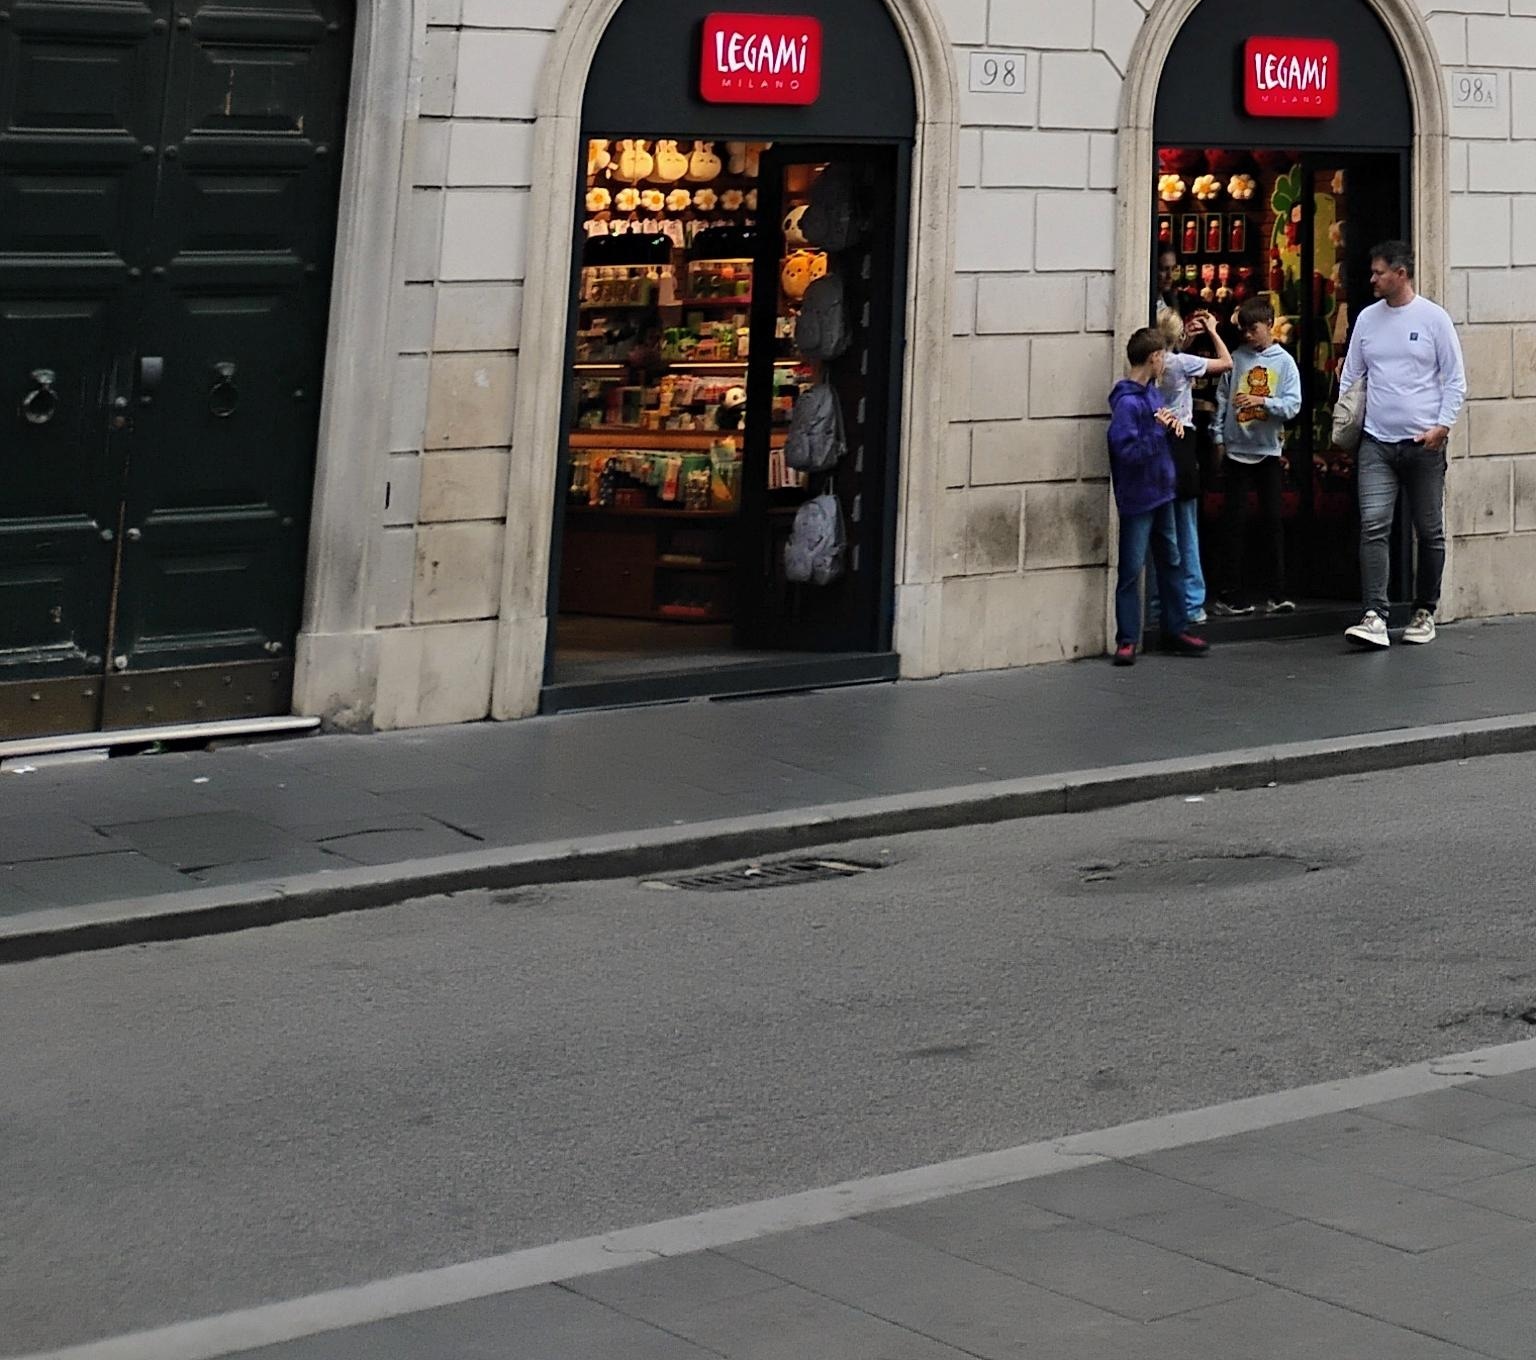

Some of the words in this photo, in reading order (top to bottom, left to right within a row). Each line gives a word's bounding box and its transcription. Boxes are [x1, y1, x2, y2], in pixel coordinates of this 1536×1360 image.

[979, 58, 1017, 87] 98
[721, 78, 800, 90] MILANO
[1455, 77, 1494, 104] 98A
[1260, 94, 1322, 106] MILANO
